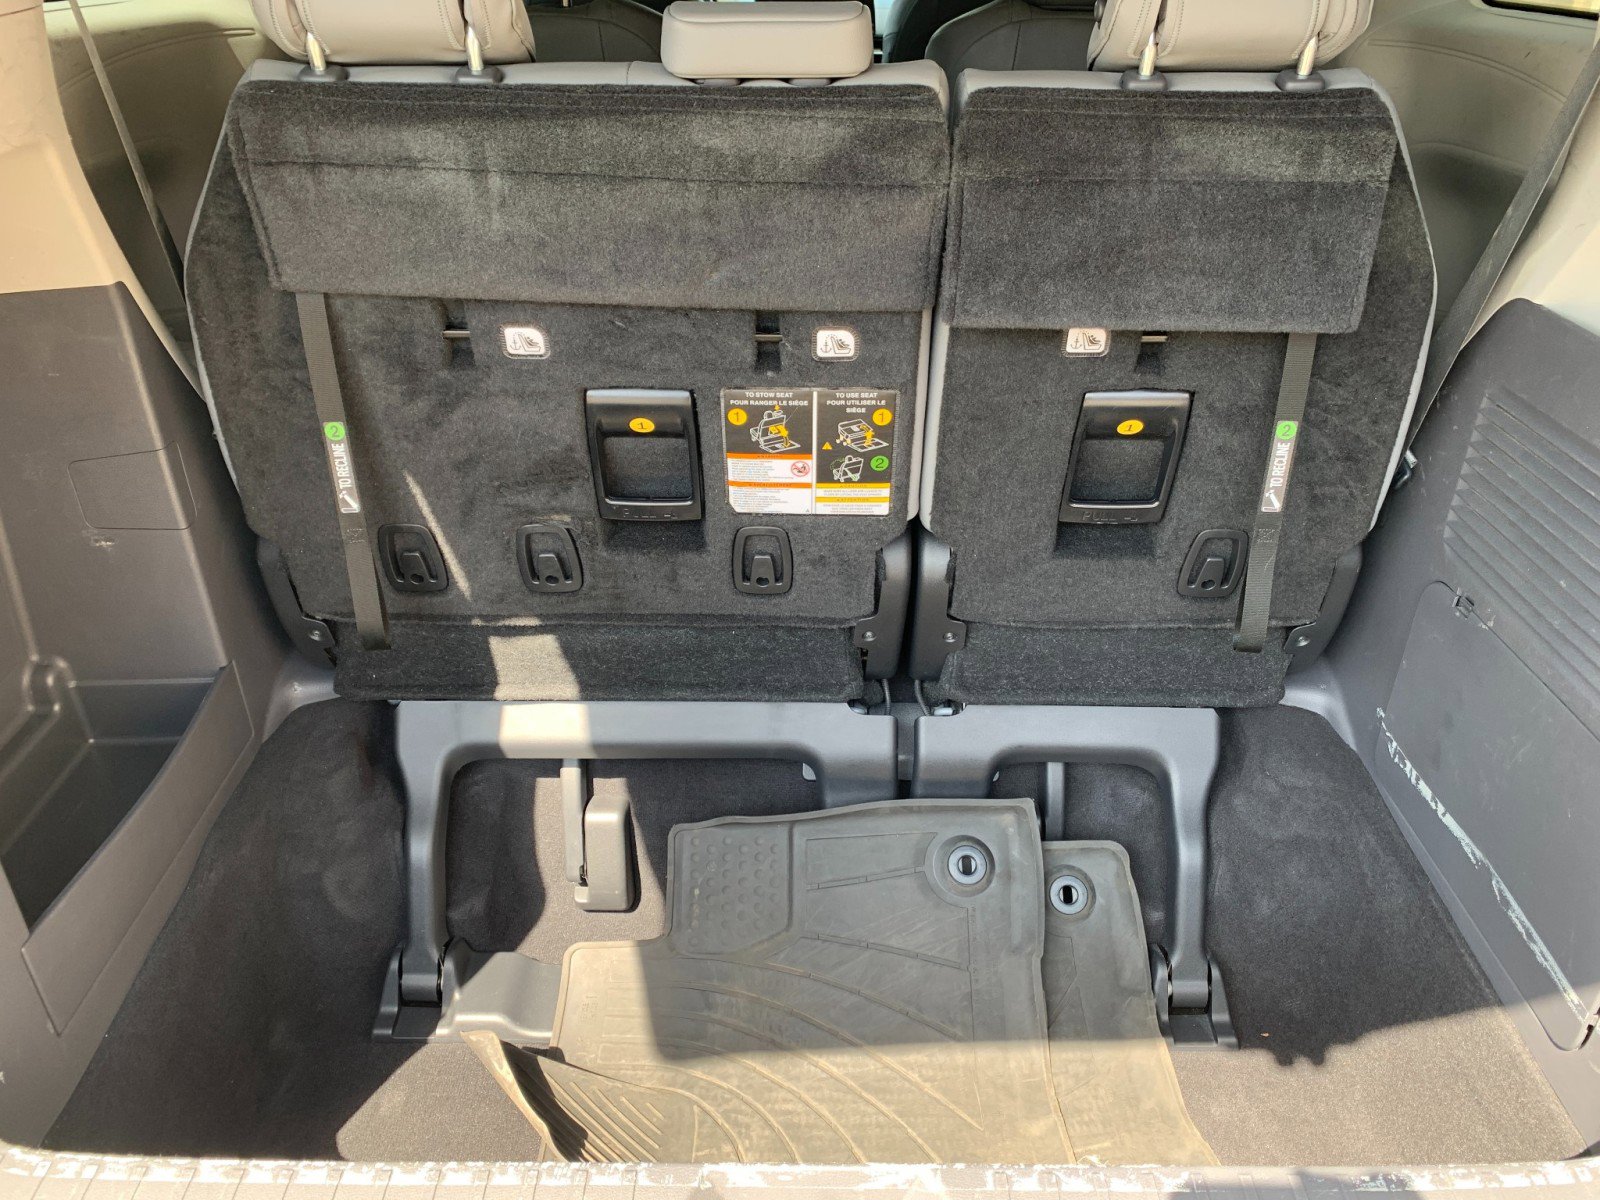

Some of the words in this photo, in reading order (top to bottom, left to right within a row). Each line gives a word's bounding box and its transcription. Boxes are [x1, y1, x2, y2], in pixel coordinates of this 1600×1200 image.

[733, 411, 740, 423] 1
[878, 411, 884, 423] 1
[637, 421, 648, 430] 1
[1282, 425, 1291, 436] 2
[331, 426, 340, 437] 2
[331, 443, 351, 477] RECLINE
[875, 458, 884, 469] 2
[1272, 442, 1291, 476] RECLINE
[338, 478, 352, 489] TO
[1269, 477, 1283, 488] TO
